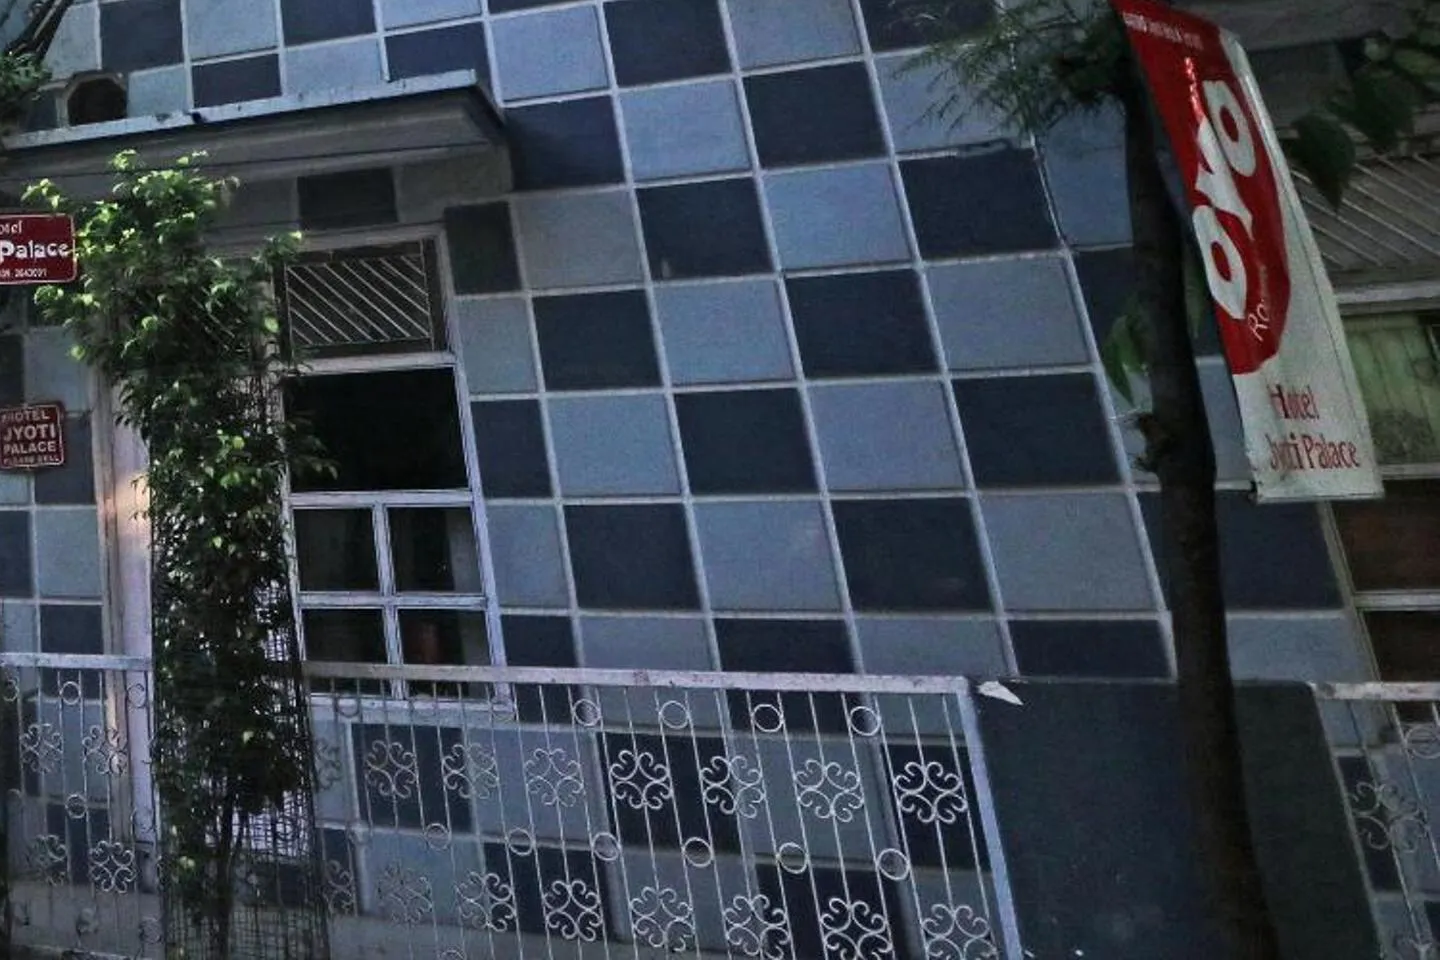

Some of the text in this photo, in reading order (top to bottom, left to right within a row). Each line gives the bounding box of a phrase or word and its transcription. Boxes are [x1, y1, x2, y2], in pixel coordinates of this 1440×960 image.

[1, 409, 50, 423] HOTEL
[3, 423, 57, 442] JYOTI
[2, 441, 57, 456] PALACE
[1300, 433, 1362, 469] Palace
